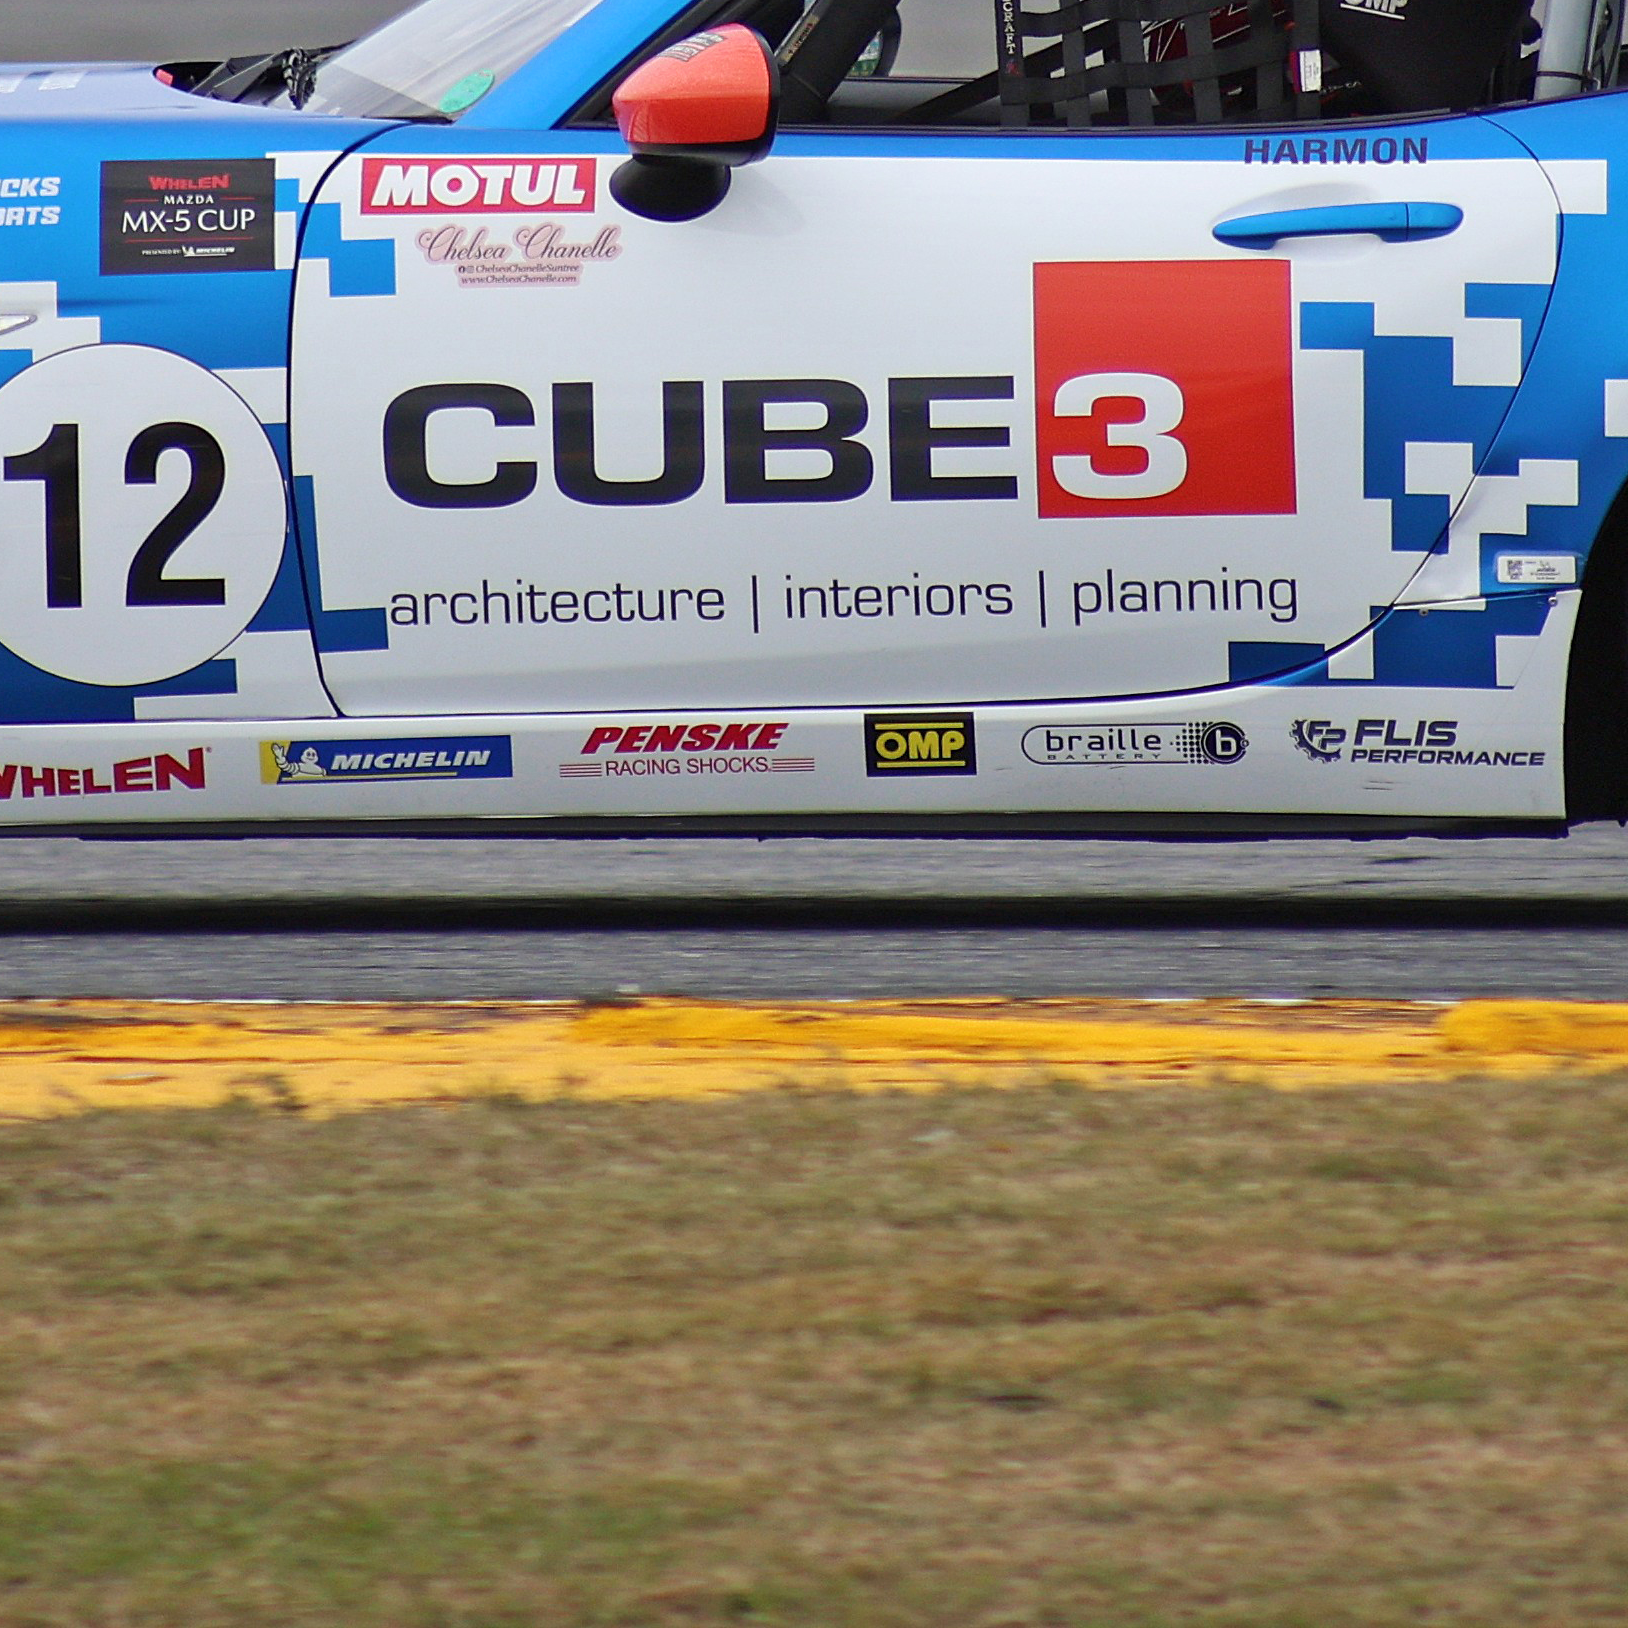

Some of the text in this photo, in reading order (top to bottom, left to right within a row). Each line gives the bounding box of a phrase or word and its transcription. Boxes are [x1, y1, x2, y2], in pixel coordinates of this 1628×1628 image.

[1243, 137, 1429, 165] HARMON
[148, 174, 231, 190] WHELEN
[371, 164, 586, 207] MOTUL
[163, 195, 215, 205] MAZDA
[122, 208, 256, 233] MX-5 CUP
[418, 223, 620, 261] Chelsea Chanelle
[3, 421, 226, 609] 12
[388, 567, 1299, 627] architecture interiors planning
[580, 722, 790, 755] PENSKE
[875, 730, 966, 760] OMP
[1045, 728, 1162, 752] braille
[1353, 719, 1459, 747] FLIS
[331, 750, 492, 770] MICHELIN
[605, 758, 680, 776] RACING
[1350, 749, 1546, 767] PERFORMANCE
